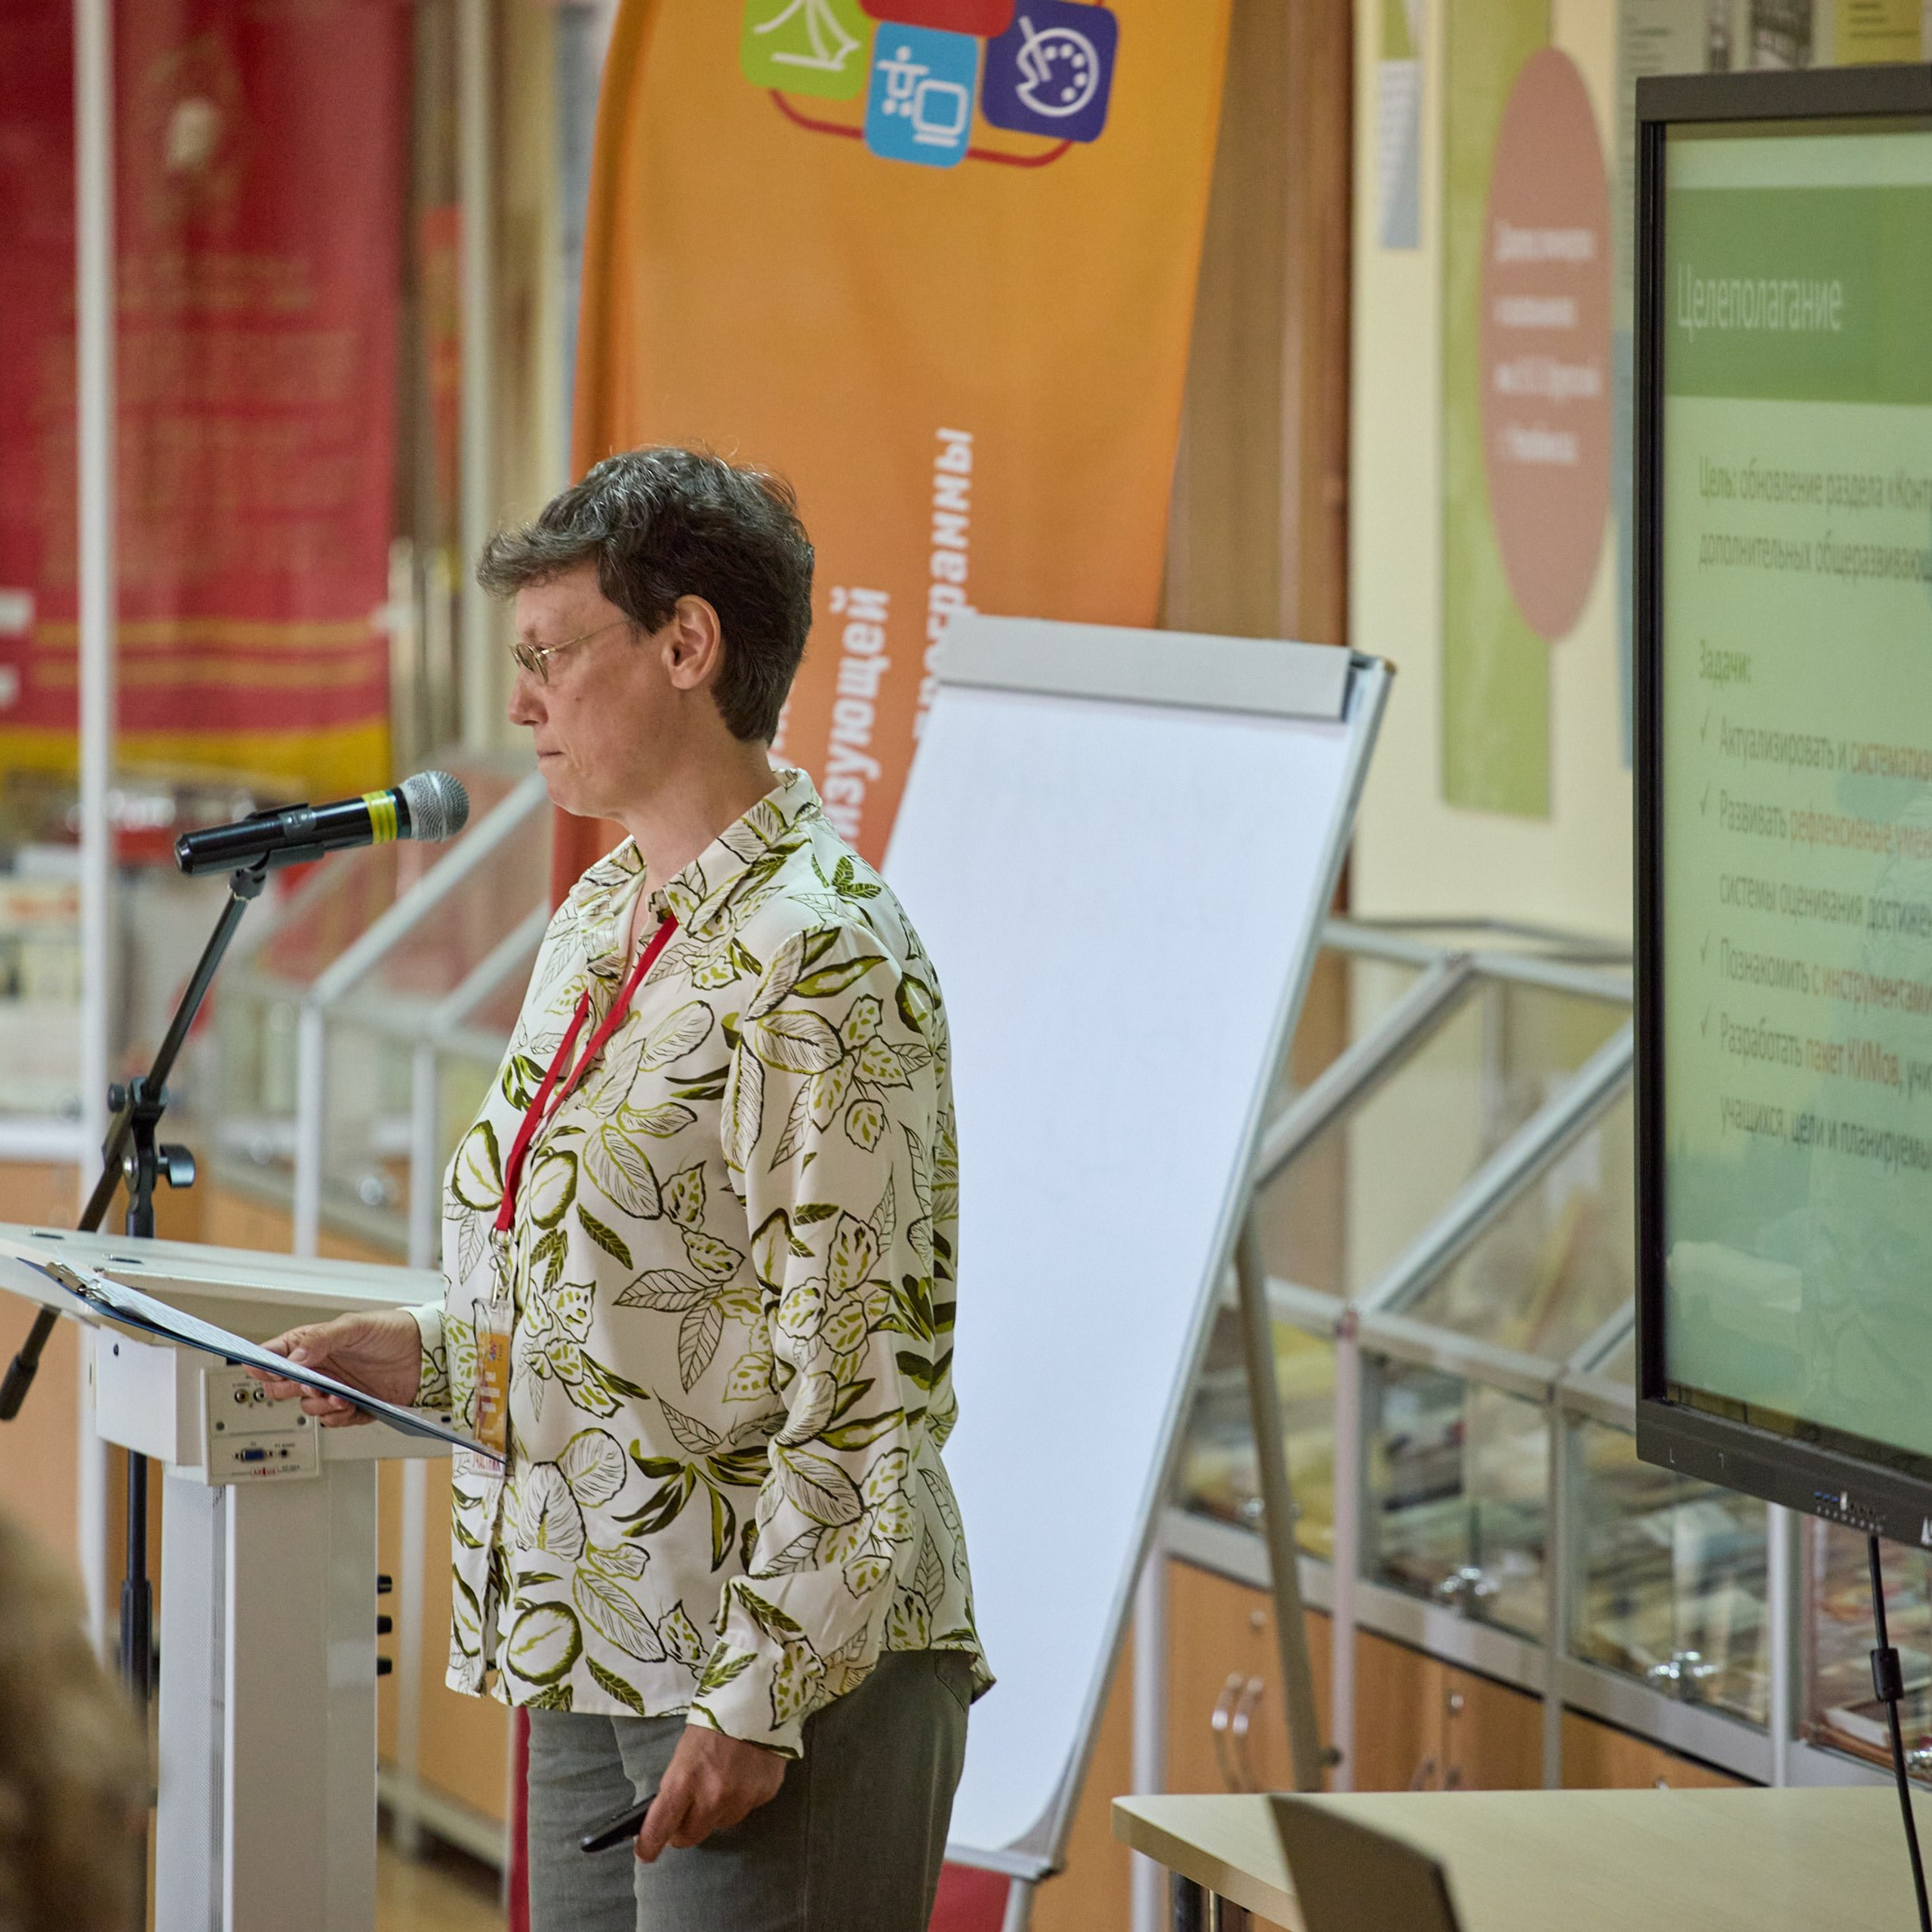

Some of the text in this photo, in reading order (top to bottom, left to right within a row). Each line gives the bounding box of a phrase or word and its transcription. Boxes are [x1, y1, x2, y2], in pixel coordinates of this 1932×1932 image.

[1678, 263, 1843, 343] Целеполагание
[1700, 456, 1735, 504] Цель:
[1740, 457, 1823, 506] обновление
[1826, 469, 1884, 515] раздела
[1700, 531, 1812, 574] дополнительных
[1720, 716, 1835, 774] Актуализировать
[1720, 789, 1788, 839] Развивать
[1720, 872, 1777, 912] системы
[1780, 881, 1864, 927] оценивания
[1720, 937, 1809, 995] Познакомить
[1720, 1011, 1803, 1069] Разработать
[1805, 1038, 1845, 1077] пакет
